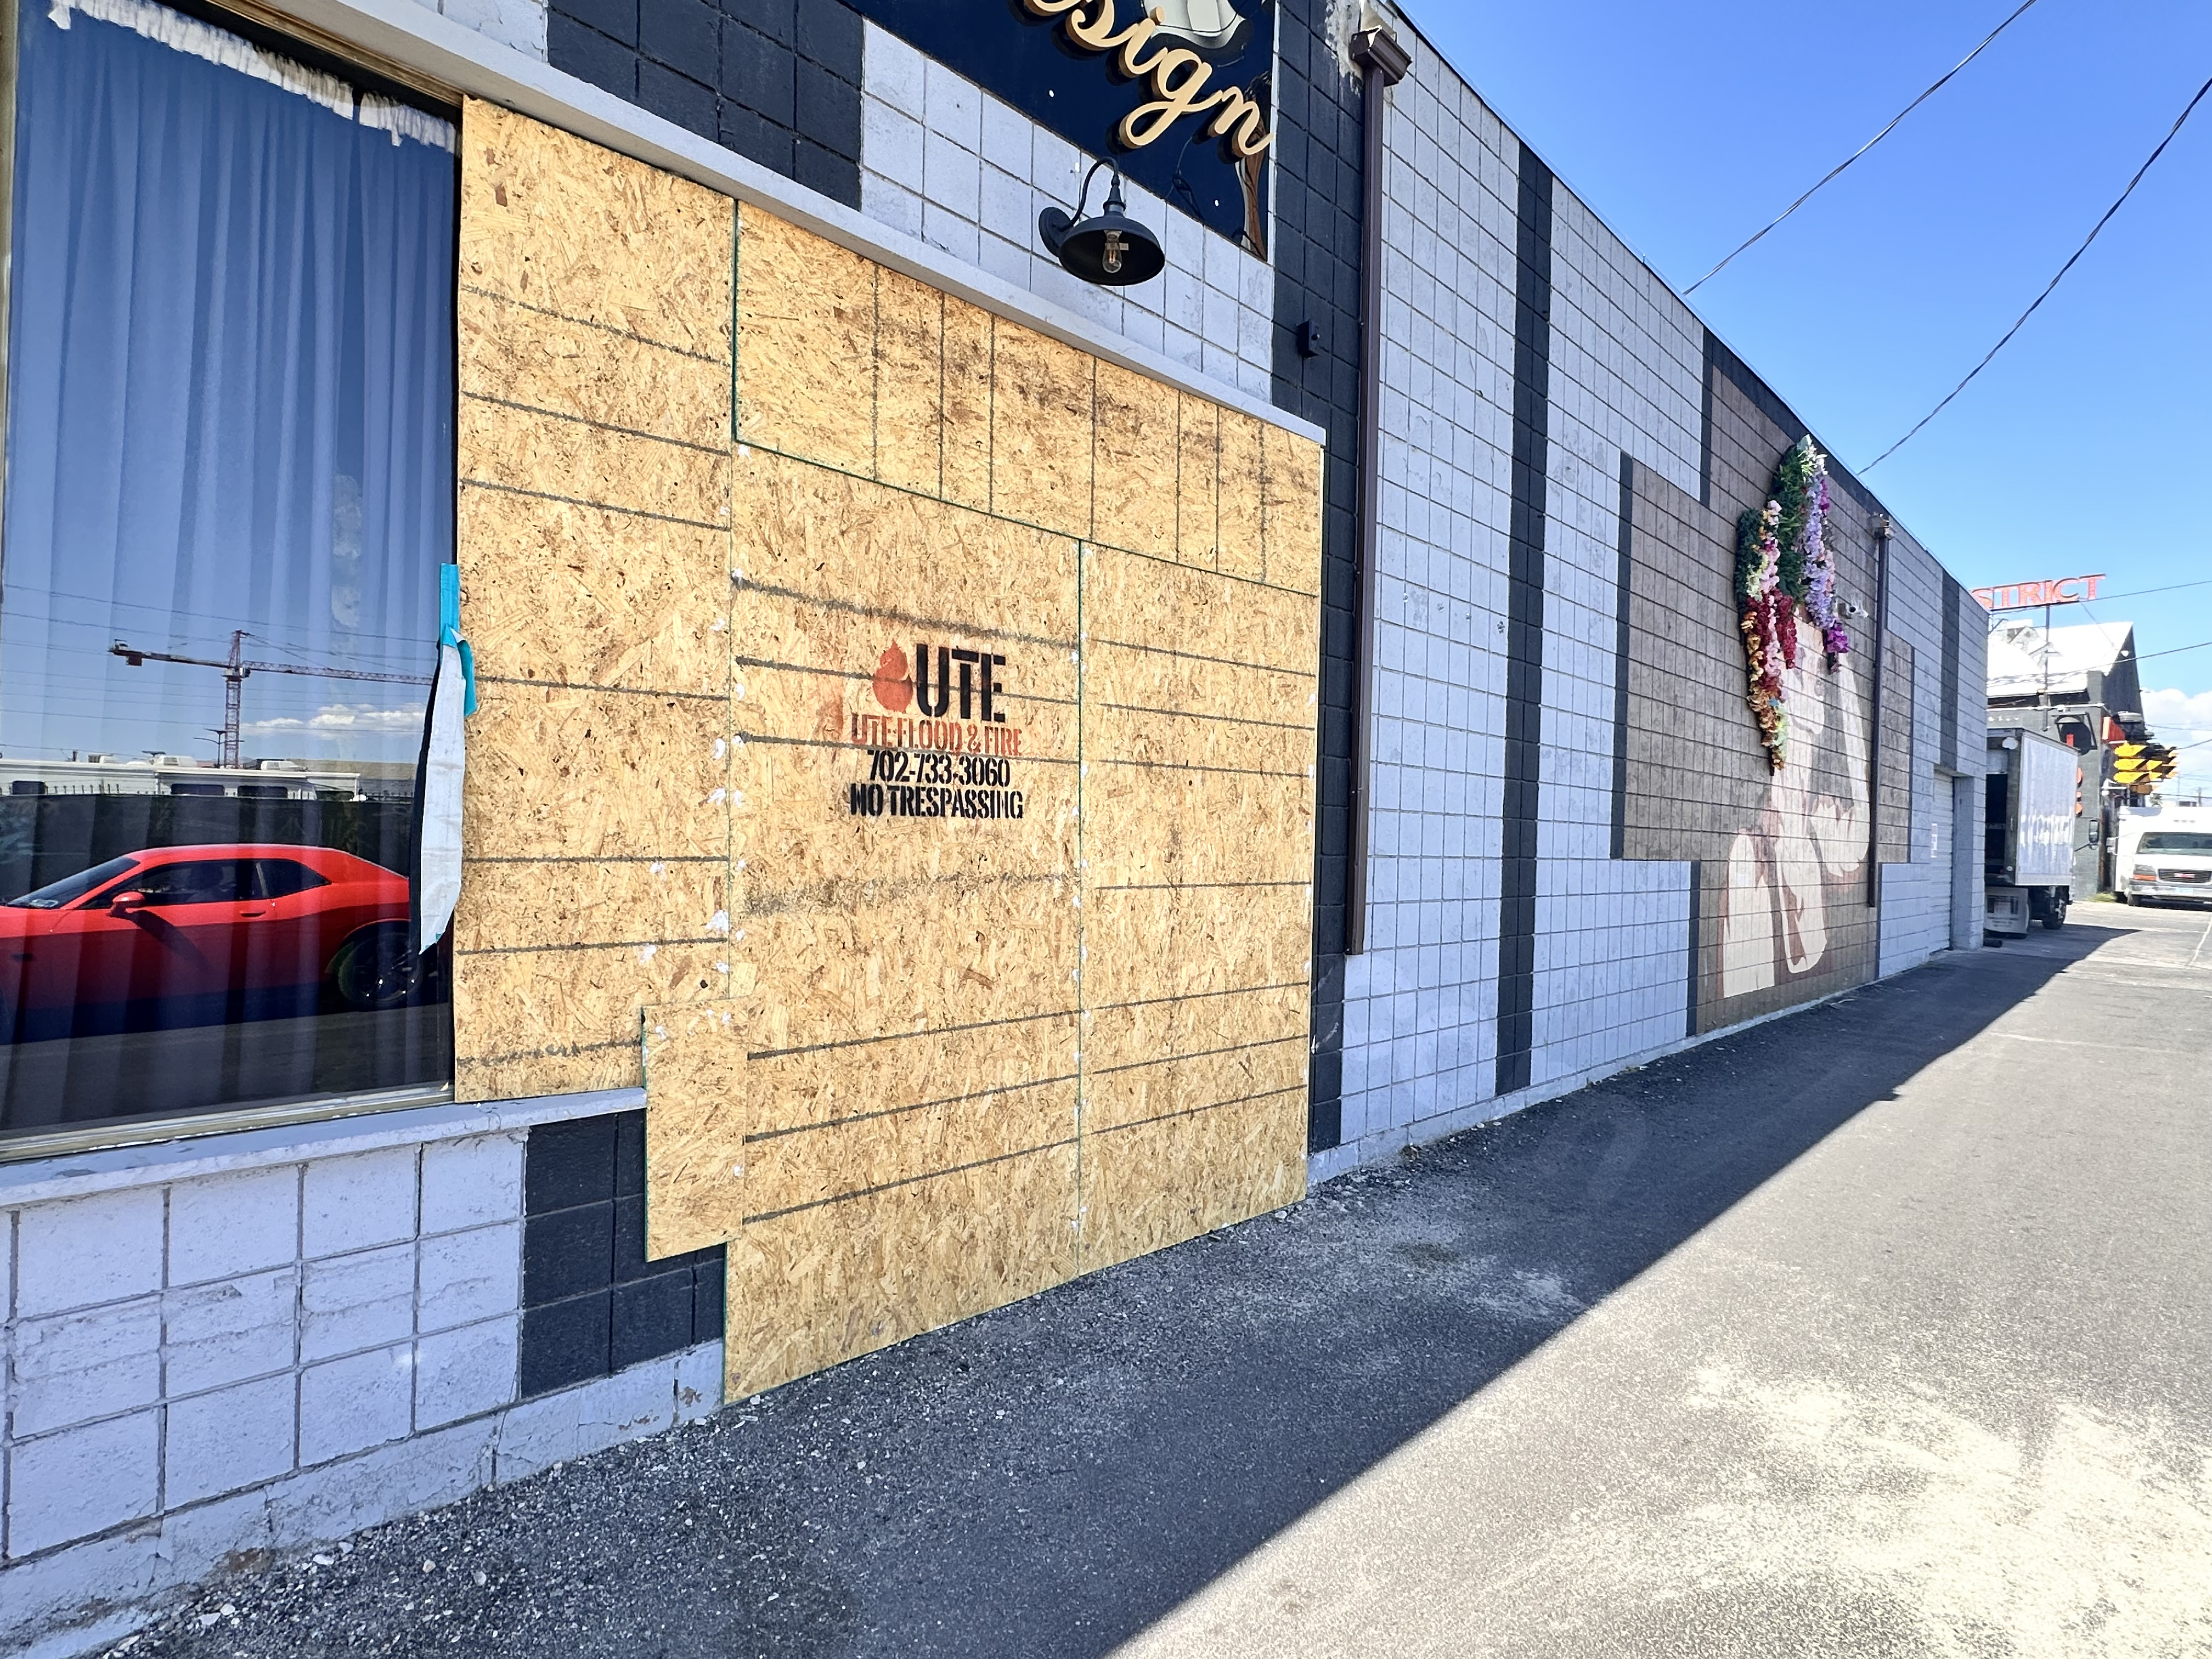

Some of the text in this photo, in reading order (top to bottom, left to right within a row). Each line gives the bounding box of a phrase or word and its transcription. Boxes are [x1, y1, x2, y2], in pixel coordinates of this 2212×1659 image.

[1025, 0, 1274, 157] sign
[917, 644, 1006, 723] UTE
[851, 713, 1023, 756] UTE FLOOD & FIRE
[867, 749, 1011, 787] 702-733-3060
[850, 783, 1024, 820] NO TRESPASSING
